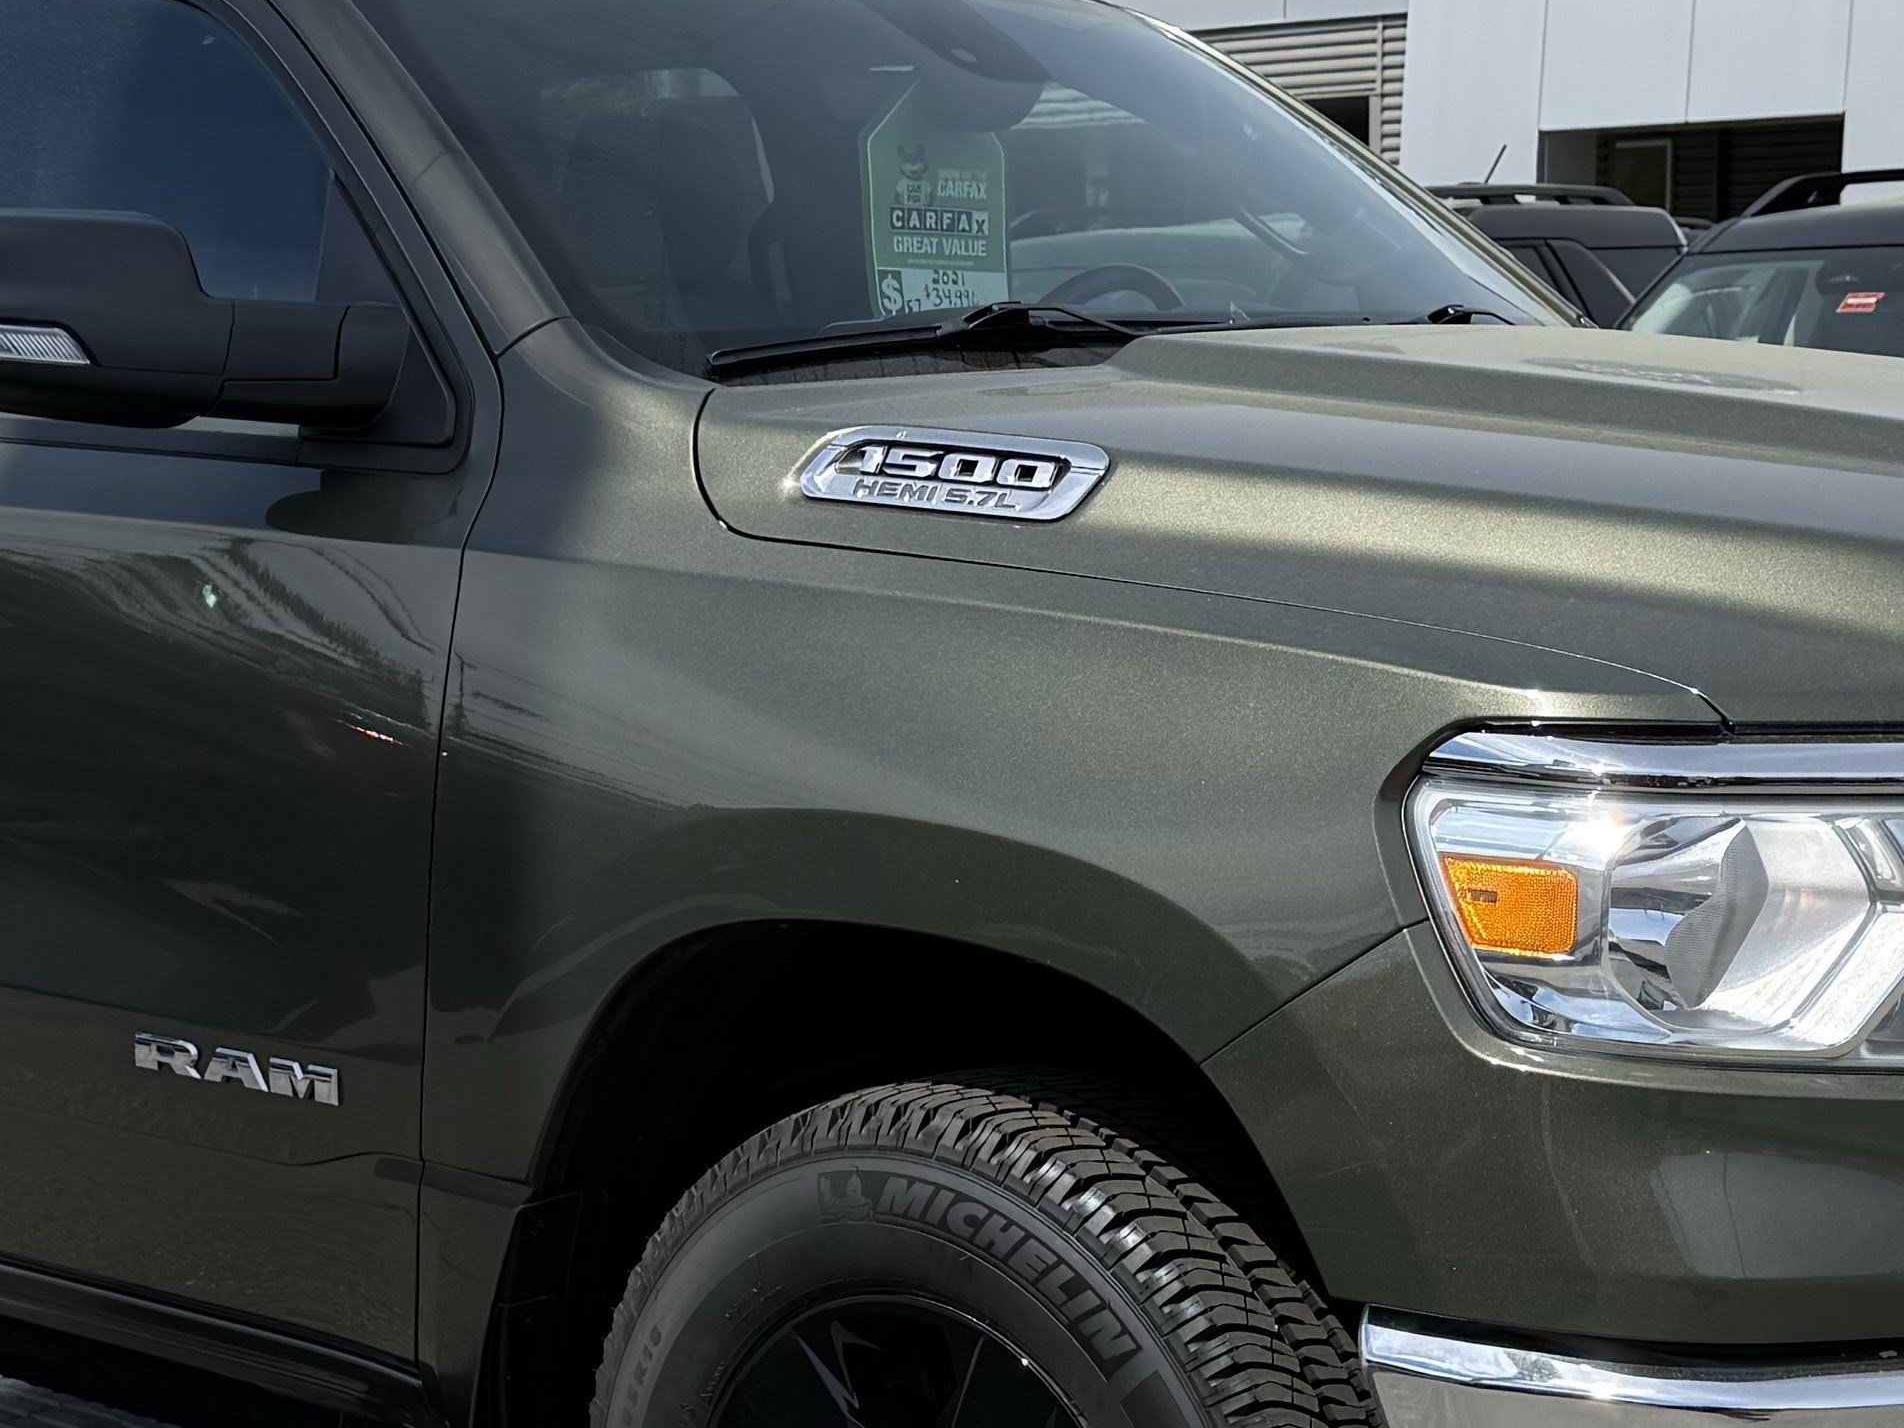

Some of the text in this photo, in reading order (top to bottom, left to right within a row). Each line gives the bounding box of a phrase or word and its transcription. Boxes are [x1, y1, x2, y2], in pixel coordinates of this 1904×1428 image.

[937, 179, 988, 200] CARFAX
[891, 209, 987, 236] CARFAX
[893, 235, 989, 257] GREAT VALUE
[881, 273, 903, 316] $
[857, 443, 1059, 490] 1500
[852, 477, 1021, 511] HEMI 5.7L
[134, 1031, 340, 1106] RAM
[875, 1174, 1141, 1362] MICHELIN
